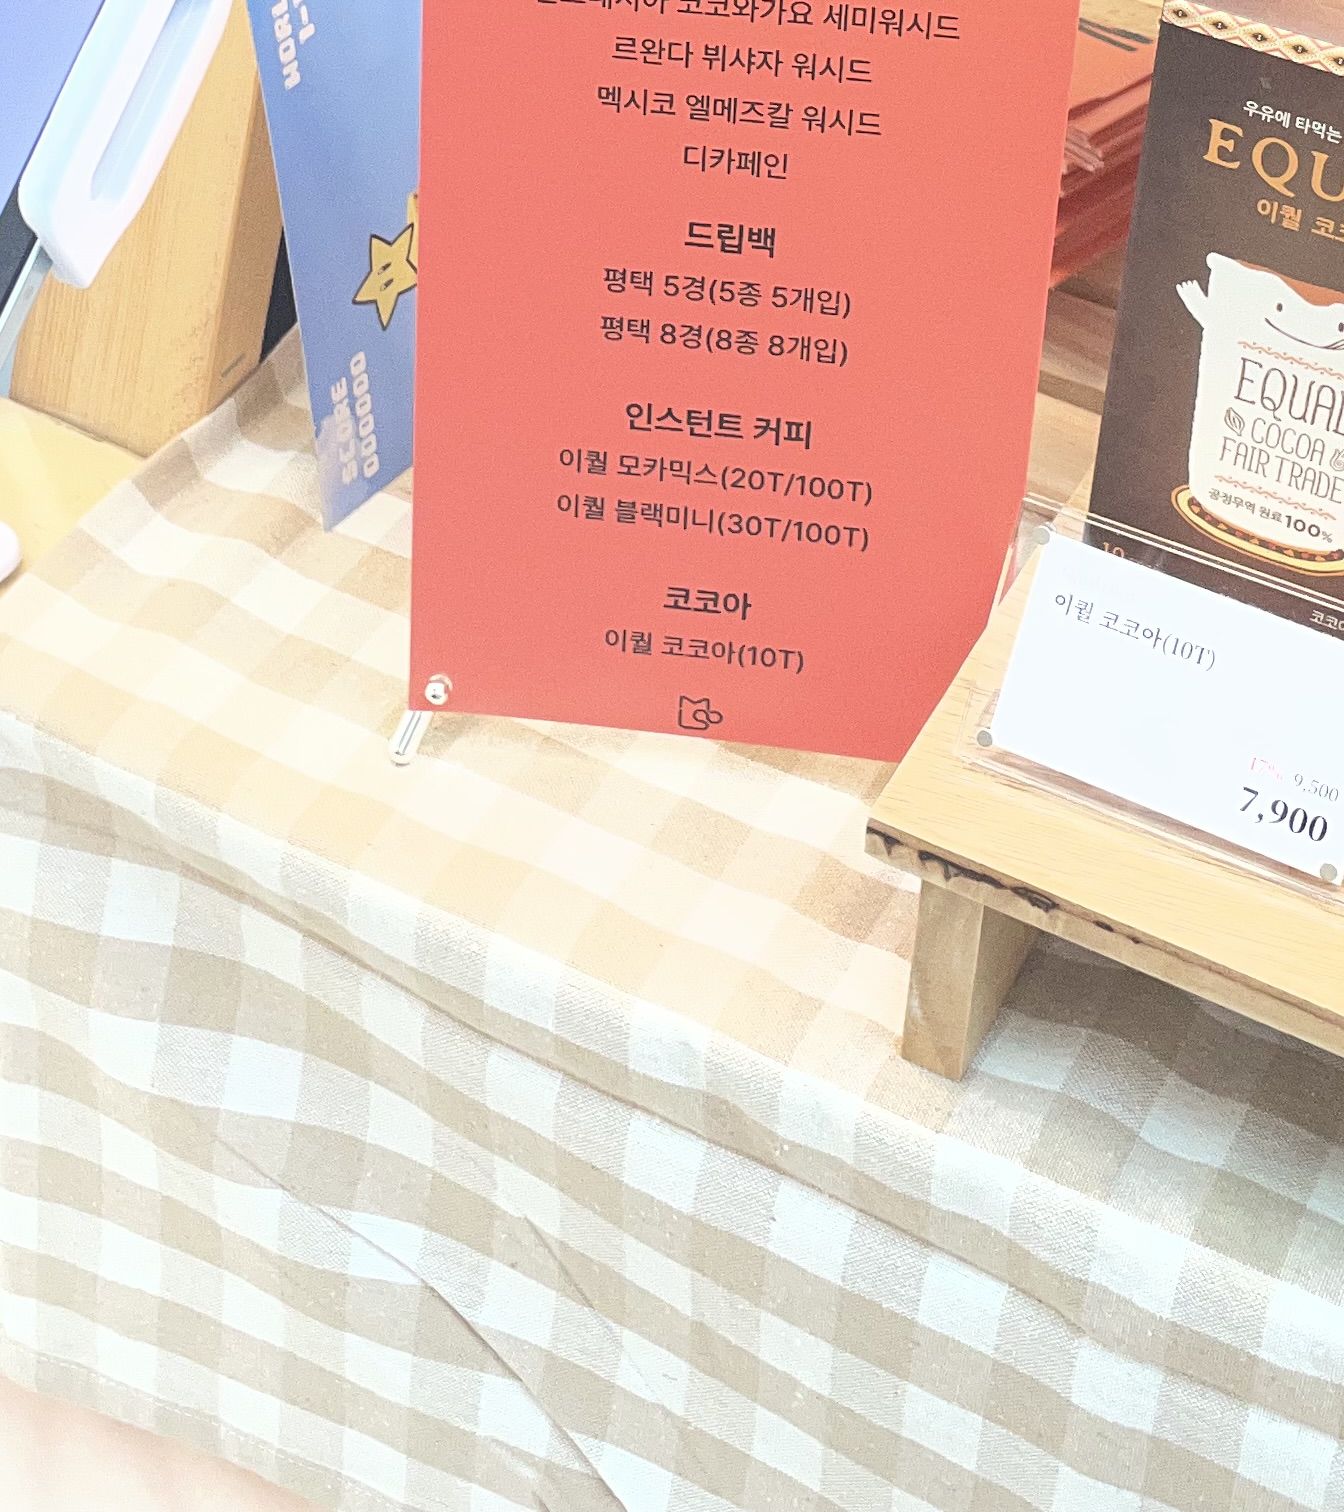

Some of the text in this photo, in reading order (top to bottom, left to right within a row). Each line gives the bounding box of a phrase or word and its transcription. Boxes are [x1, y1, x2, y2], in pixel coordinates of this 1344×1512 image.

[822, 3, 961, 41] 세미워시드
[611, 34, 873, 86] 르완다 뷔샤자 워시드
[597, 84, 883, 137] 멕시코 엘메즈칼 워시드
[1242, 99, 1292, 131] 우유에
[1294, 113, 1344, 145] 타먹는
[682, 143, 789, 180] 디카페인
[684, 221, 778, 258] 드립백
[1255, 198, 1304, 232] 이퀄
[602, 268, 852, 319] 평택 5경(5종 5개입)
[599, 316, 850, 368] 평택 8경(8종 8개입)
[331, 376, 358, 484] SCORE
[625, 403, 814, 450] 인스턴트 커피
[1249, 417, 1327, 467] COCOA
[559, 449, 873, 507] 이퀄 모카믹스(20T/100T)
[1207, 486, 1257, 516] 공정무역
[556, 494, 871, 554] 이퀄 블랙미니(30T/100T)
[662, 586, 752, 621] 코코아
[604, 629, 805, 676] 이퀄 코코아(10T)
[1054, 592, 1217, 672] 이퀄 코코아(10T)
[1237, 784, 1330, 844] 7,900
